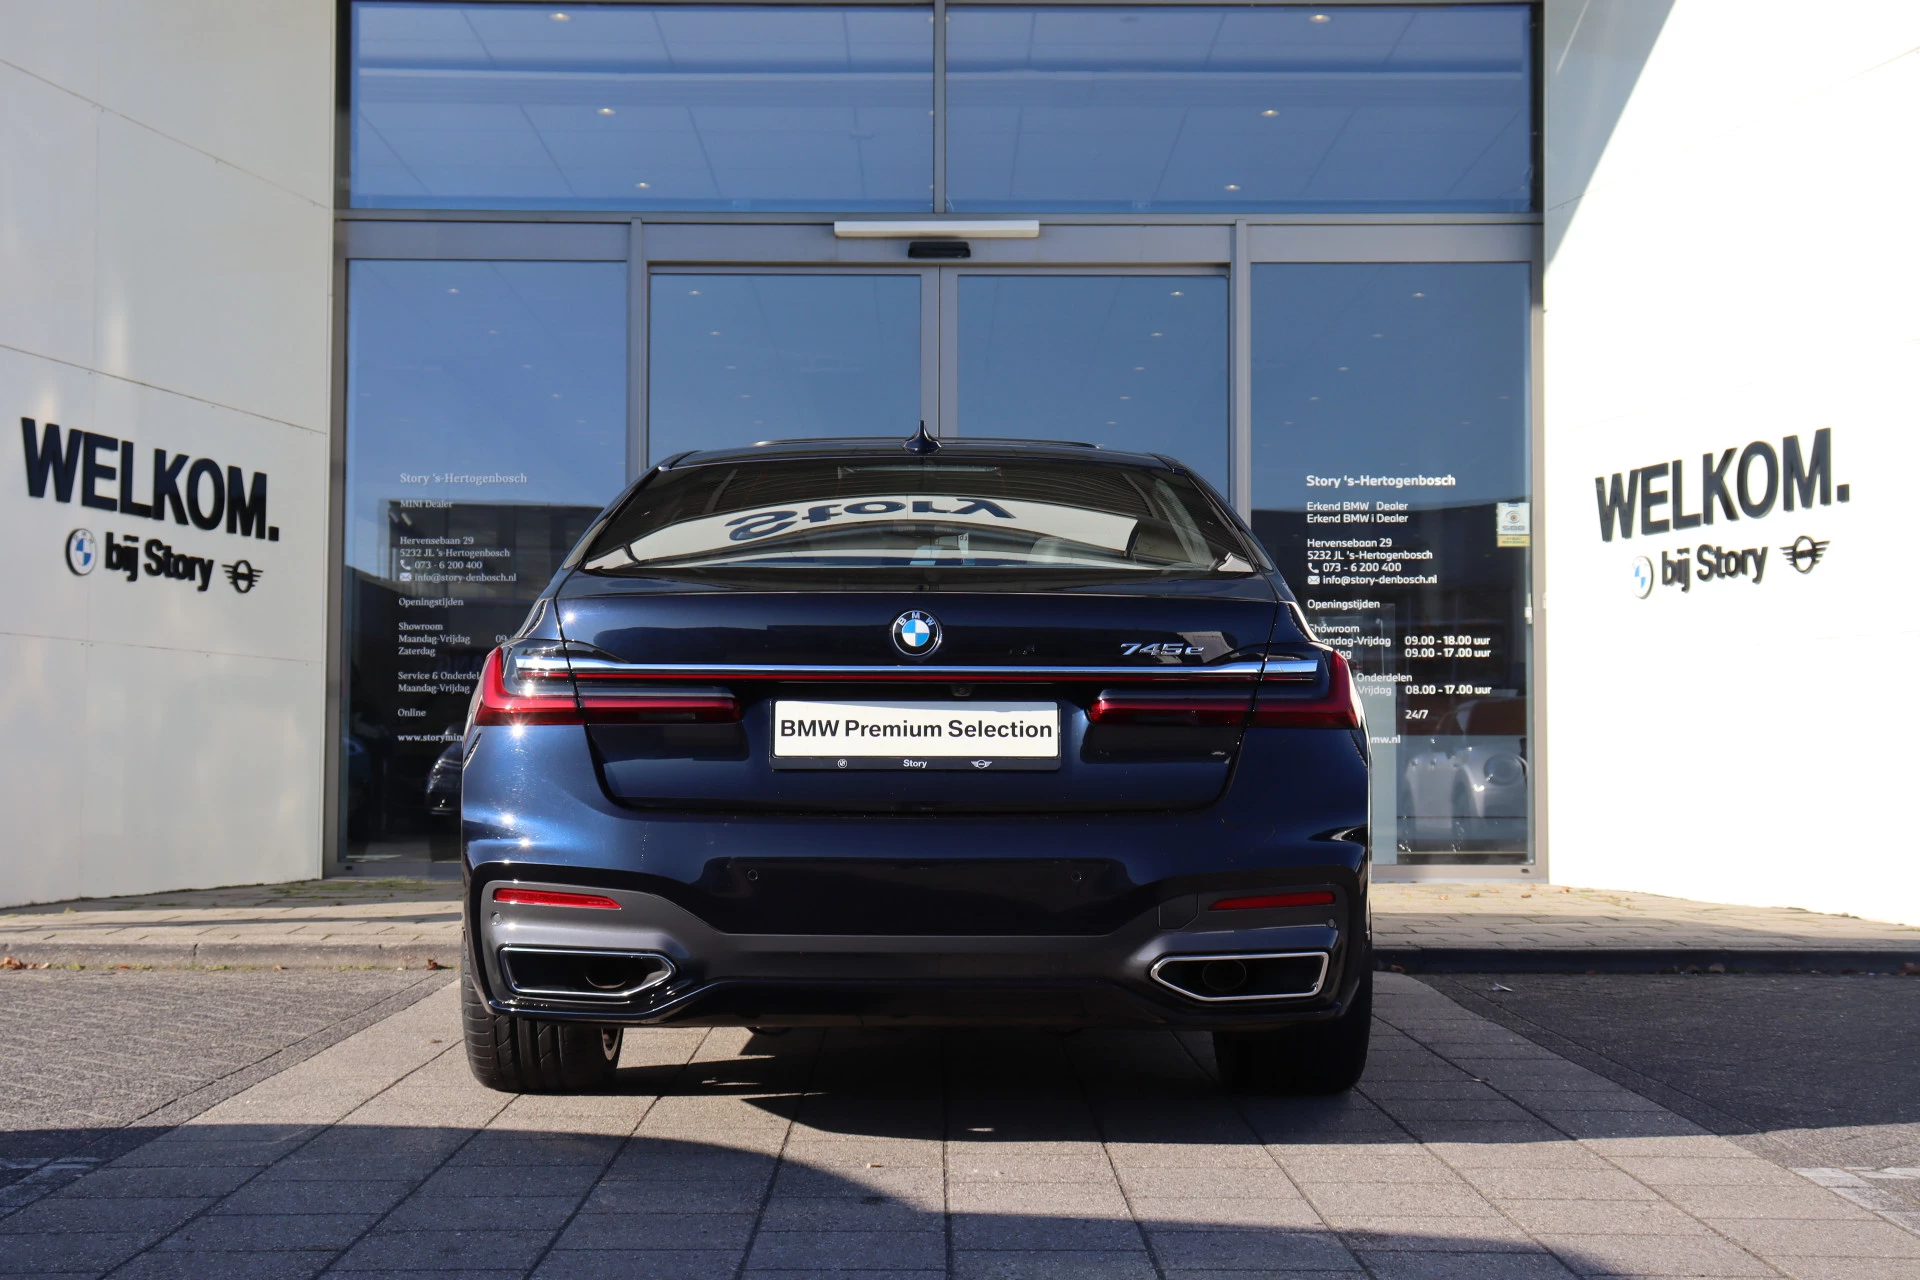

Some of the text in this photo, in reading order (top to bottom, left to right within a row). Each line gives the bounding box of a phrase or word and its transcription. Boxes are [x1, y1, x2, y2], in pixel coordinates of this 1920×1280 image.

[21, 417, 279, 541] WELKOM.
[400, 473, 429, 486] Story
[1306, 475, 1341, 488] Story
[1595, 427, 1850, 542] WELKOM.
[400, 500, 453, 508] MINI Dealer
[1307, 502, 1408, 511] Erkend BMW Dealer
[1307, 514, 1341, 523] Erkend
[1343, 514, 1370, 523] BMW
[1376, 514, 1408, 523] Dealer
[400, 536, 474, 545] Hervensebaan 29
[1307, 538, 1393, 548] Hervensebaan 29
[400, 549, 422, 557] 5232
[423, 549, 435, 557] JL
[1307, 551, 1332, 560] 5232
[1333, 551, 1344, 560] JL
[105, 531, 214, 592] bij Story
[414, 561, 431, 569] 073
[438, 561, 445, 569] 6
[447, 561, 464, 569] 200
[465, 561, 483, 569] 400
[1322, 563, 1341, 572] 073
[1350, 563, 1357, 572] 6
[1359, 563, 1380, 572] 200
[1381, 563, 1402, 572] 400
[1661, 544, 1769, 593] bij Story
[414, 573, 517, 584] info@story-denbosch.nl
[1322, 575, 1438, 586] info@story-denbosch.nl
[398, 598, 464, 608] Openingstijden
[1307, 599, 1381, 611] Openingstijden
[398, 622, 443, 631] Showroom
[398, 634, 471, 645] Maandag-Vrijdag
[1320, 636, 1392, 647] andag-Vrijdag
[1404, 636, 1435, 645] 09.00
[1443, 636, 1472, 645] 18.00
[1474, 637, 1491, 645] uur
[398, 647, 436, 657] Zaterdag
[1120, 643, 1204, 656] 745e
[1404, 648, 1435, 658] 09.00
[1475, 649, 1491, 658] uur
[398, 671, 430, 680] Service
[440, 671, 481, 680] Onderdel
[1356, 673, 1413, 682] Onderdelen
[398, 683, 470, 694] Maandag-Vrijdag
[1357, 685, 1392, 696] Vrijdag
[1405, 685, 1436, 695] 08.00
[1474, 686, 1492, 695] uur
[397, 708, 427, 717] Online
[1405, 709, 1429, 719] 24/7
[780, 719, 1052, 738] BMW Premium Selection
[397, 733, 464, 744] www.storymin
[903, 758, 928, 769] Story
